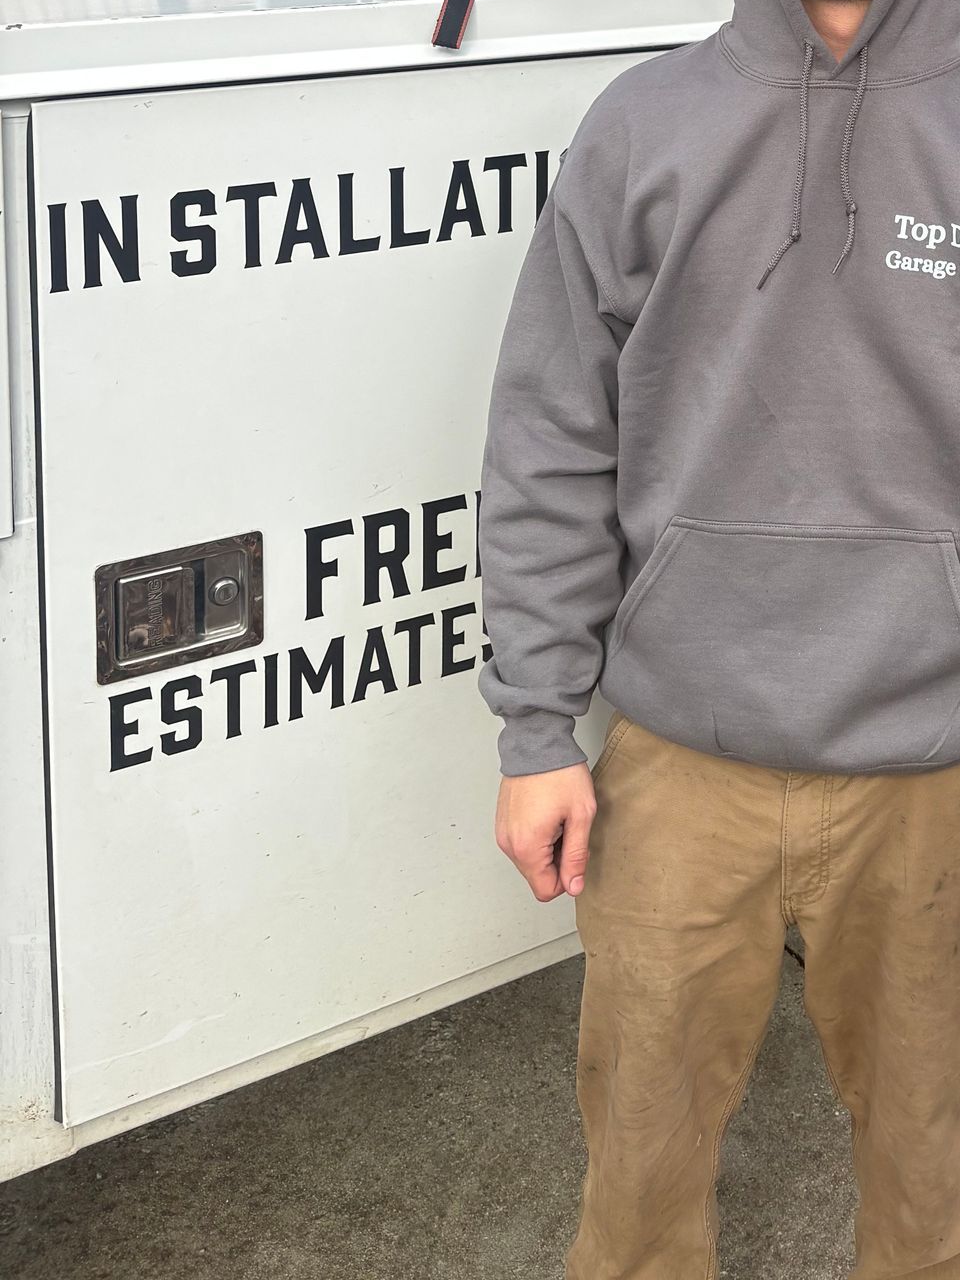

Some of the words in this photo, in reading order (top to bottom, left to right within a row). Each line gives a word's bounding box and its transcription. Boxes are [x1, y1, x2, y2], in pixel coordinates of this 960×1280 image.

[47, 149, 567, 293] INSTALLATI
[894, 214, 947, 249] Top
[885, 250, 957, 280] Garage
[304, 490, 482, 621] FRE
